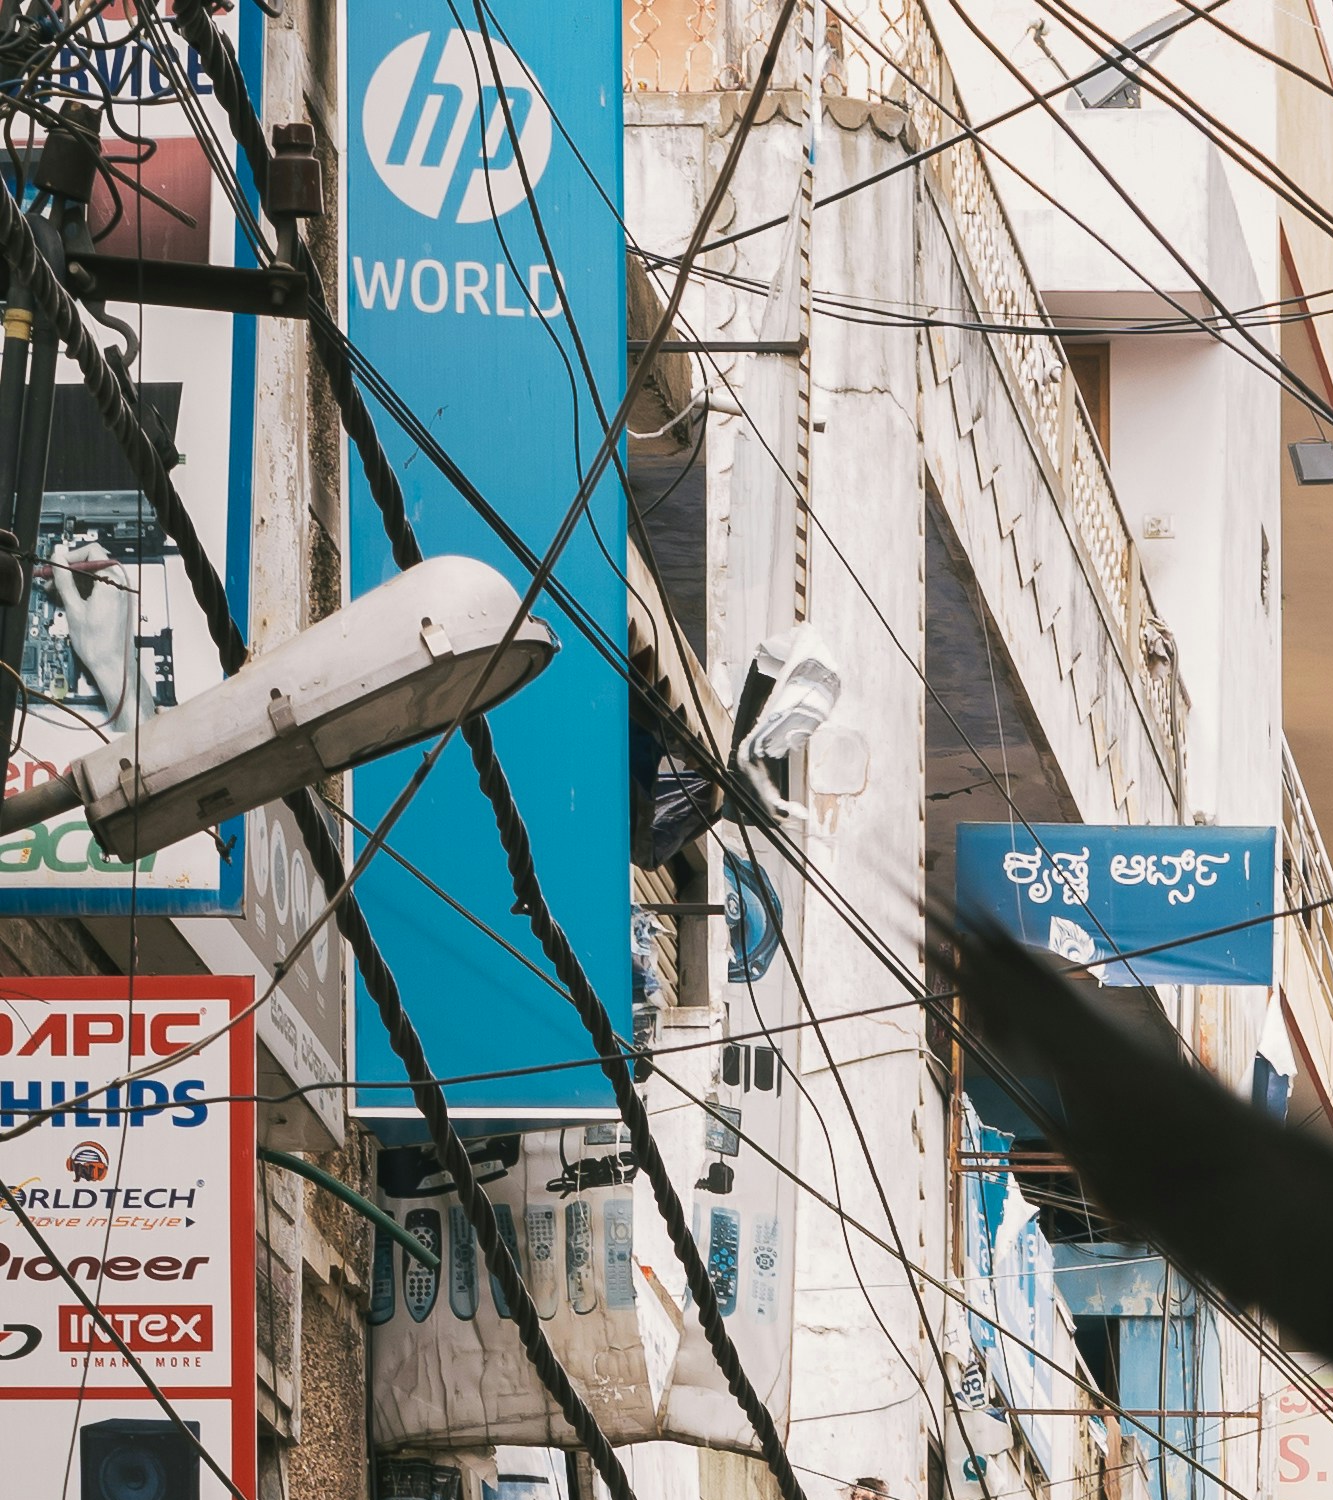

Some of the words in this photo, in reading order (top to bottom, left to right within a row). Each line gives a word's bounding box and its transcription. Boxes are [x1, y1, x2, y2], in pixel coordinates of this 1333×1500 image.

[354, 259, 564, 318] WORLD
[70, 1313, 201, 1343] INTEX
[71, 1357, 142, 1367] DEMAND
[156, 1357, 201, 1367] MORE
